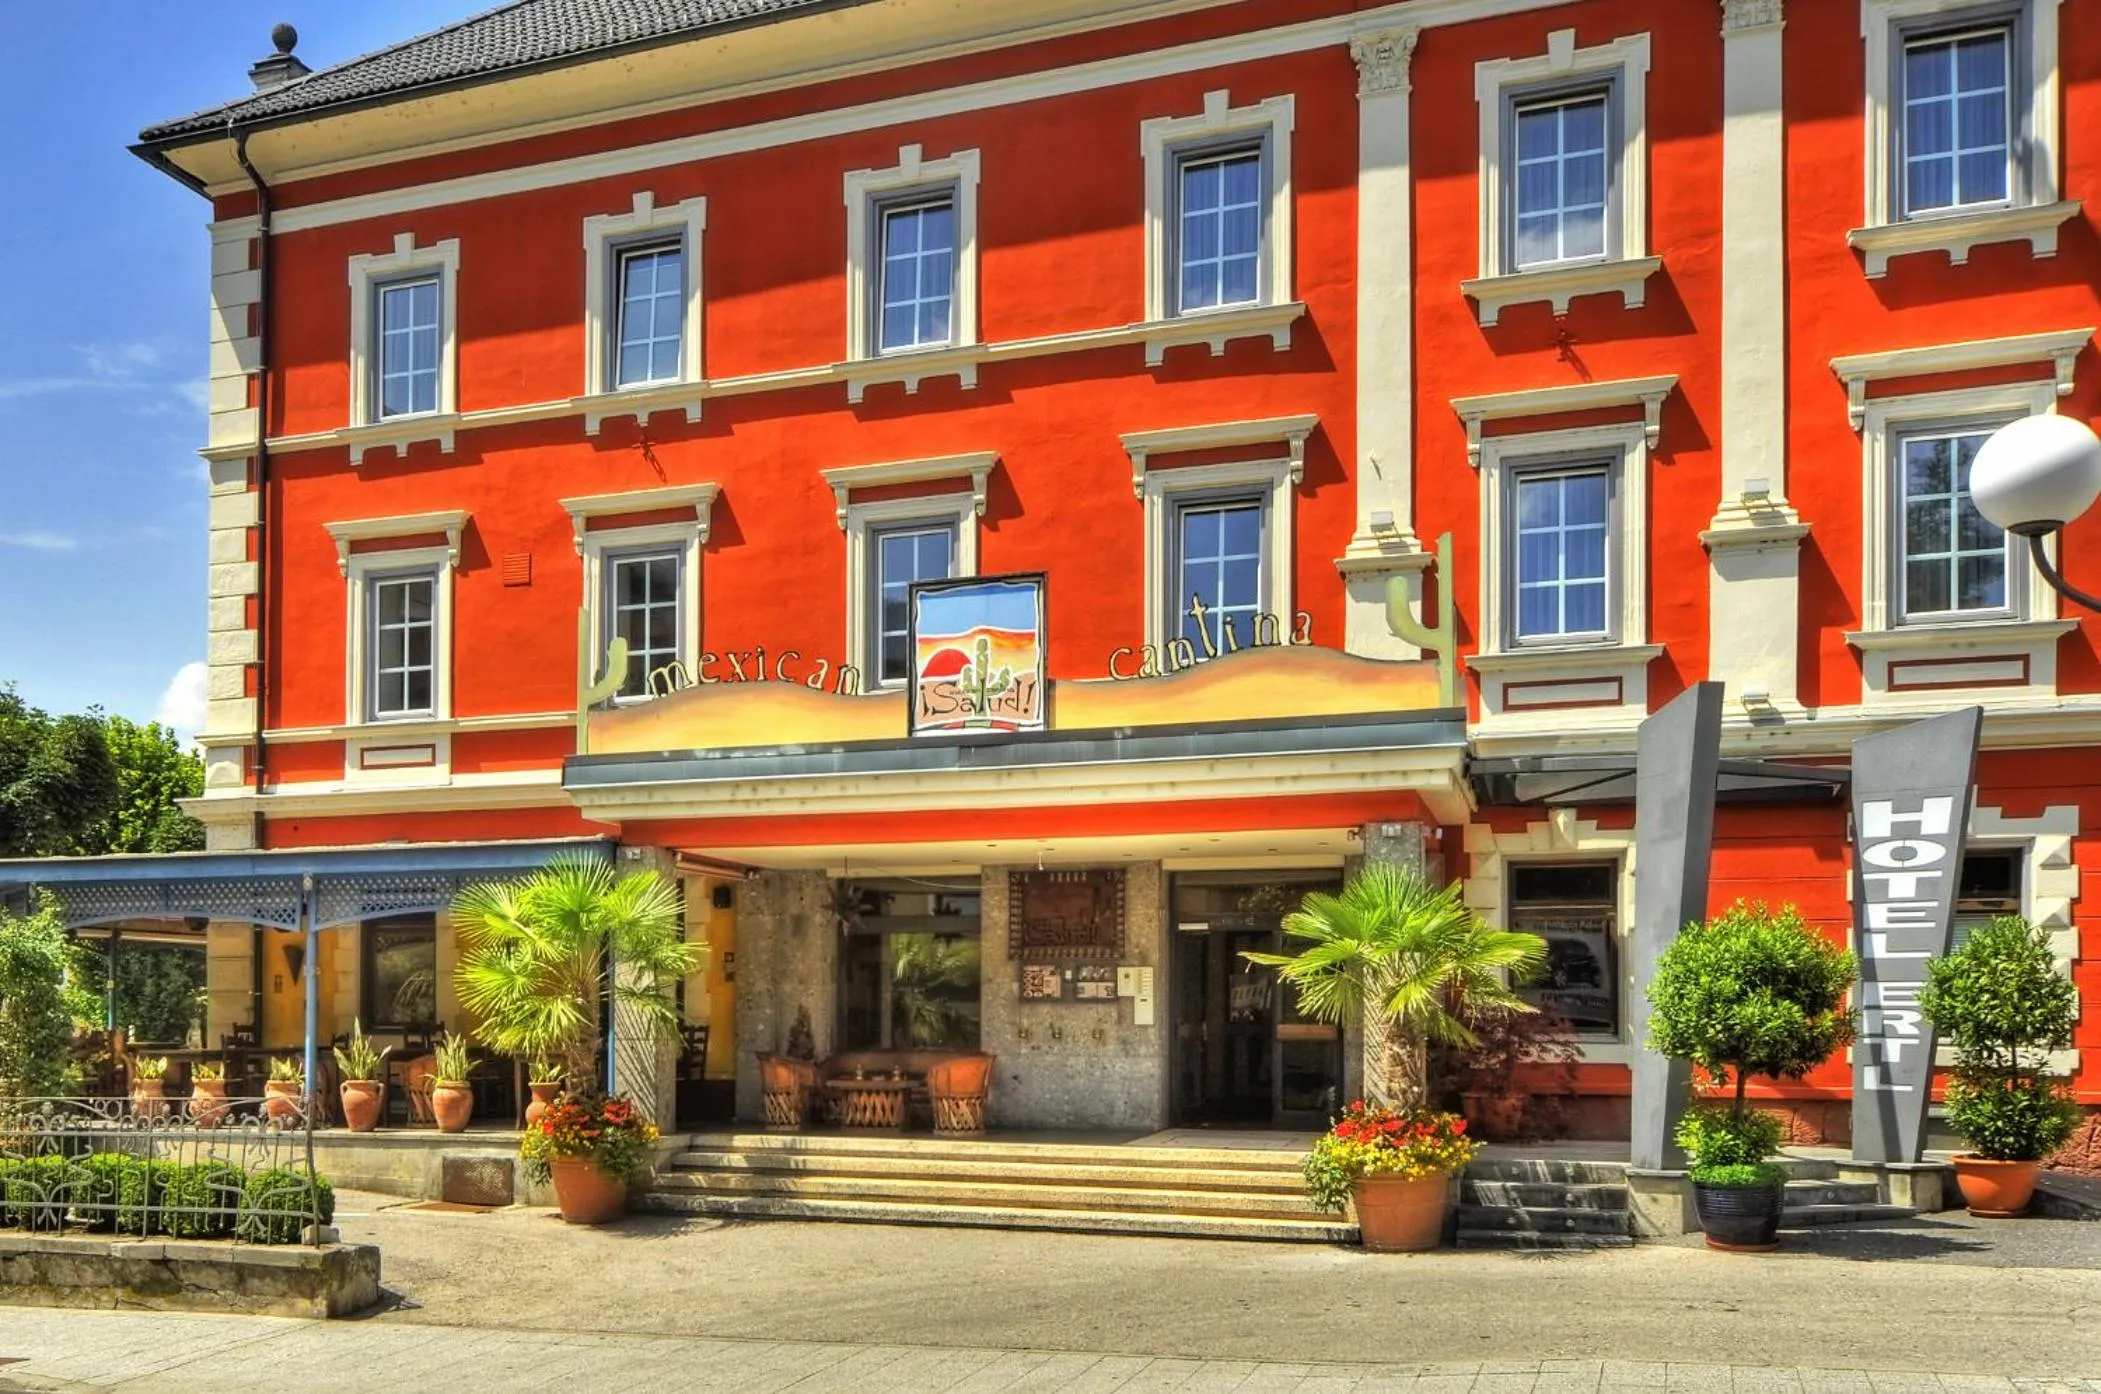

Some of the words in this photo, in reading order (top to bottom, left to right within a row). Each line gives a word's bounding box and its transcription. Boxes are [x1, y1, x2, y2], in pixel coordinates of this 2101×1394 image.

[647, 645, 862, 698] mexican
[1109, 592, 1316, 681] cantina
[1862, 797, 1953, 960] HOTEL
[1862, 981, 1925, 1092] ERTL
